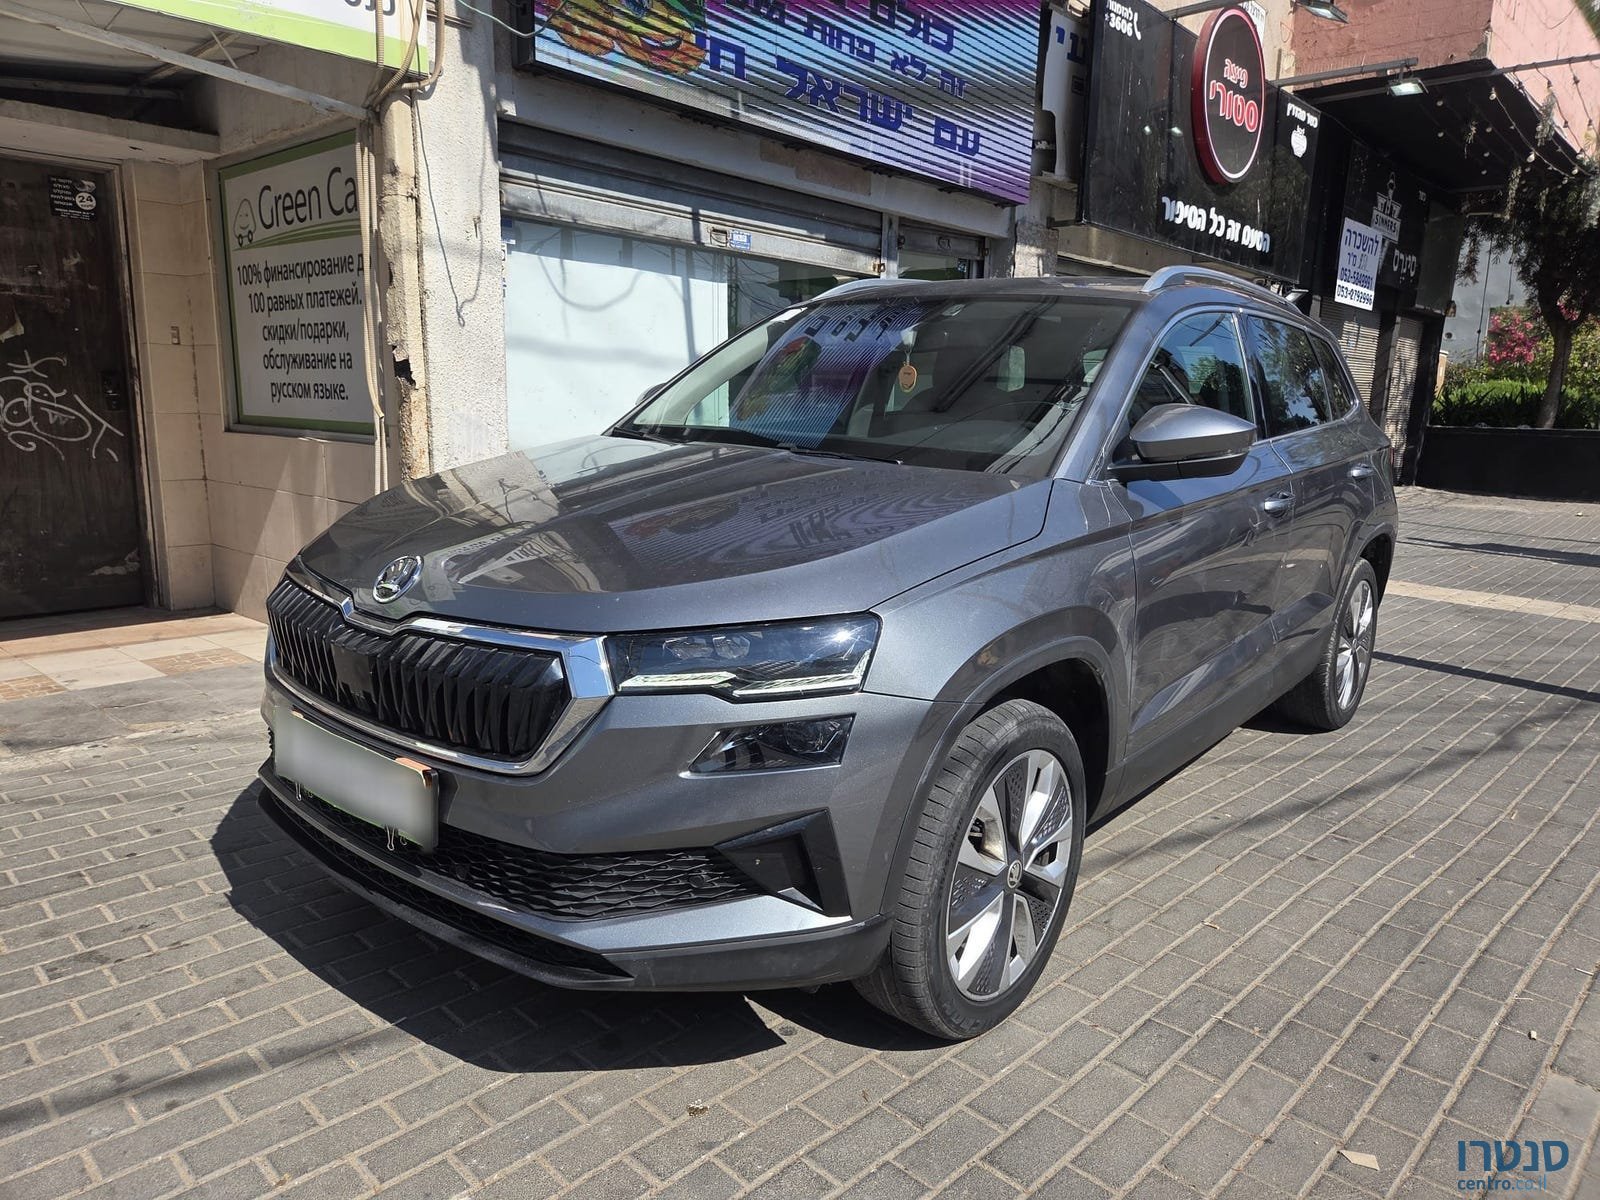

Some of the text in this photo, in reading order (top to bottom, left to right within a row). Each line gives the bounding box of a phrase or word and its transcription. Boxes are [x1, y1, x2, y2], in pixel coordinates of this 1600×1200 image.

[891, 50, 927, 81] לא
[1223, 58, 1249, 89] פיצה
[695, 30, 980, 156] עם ישראל חי
[1209, 79, 1259, 133] סטורי
[258, 166, 358, 230] Green Ca
[1161, 195, 1271, 254] הטעם זה כל הסיפור
[1344, 228, 1379, 257] להשכרה
[237, 263, 262, 286] 100%
[263, 254, 354, 288] финансирование
[248, 282, 362, 318] 100 равных платежей.
[262, 318, 350, 345] скидки/подарки,
[263, 347, 353, 375] обслуживание на
[270, 381, 349, 403] русском языке.
